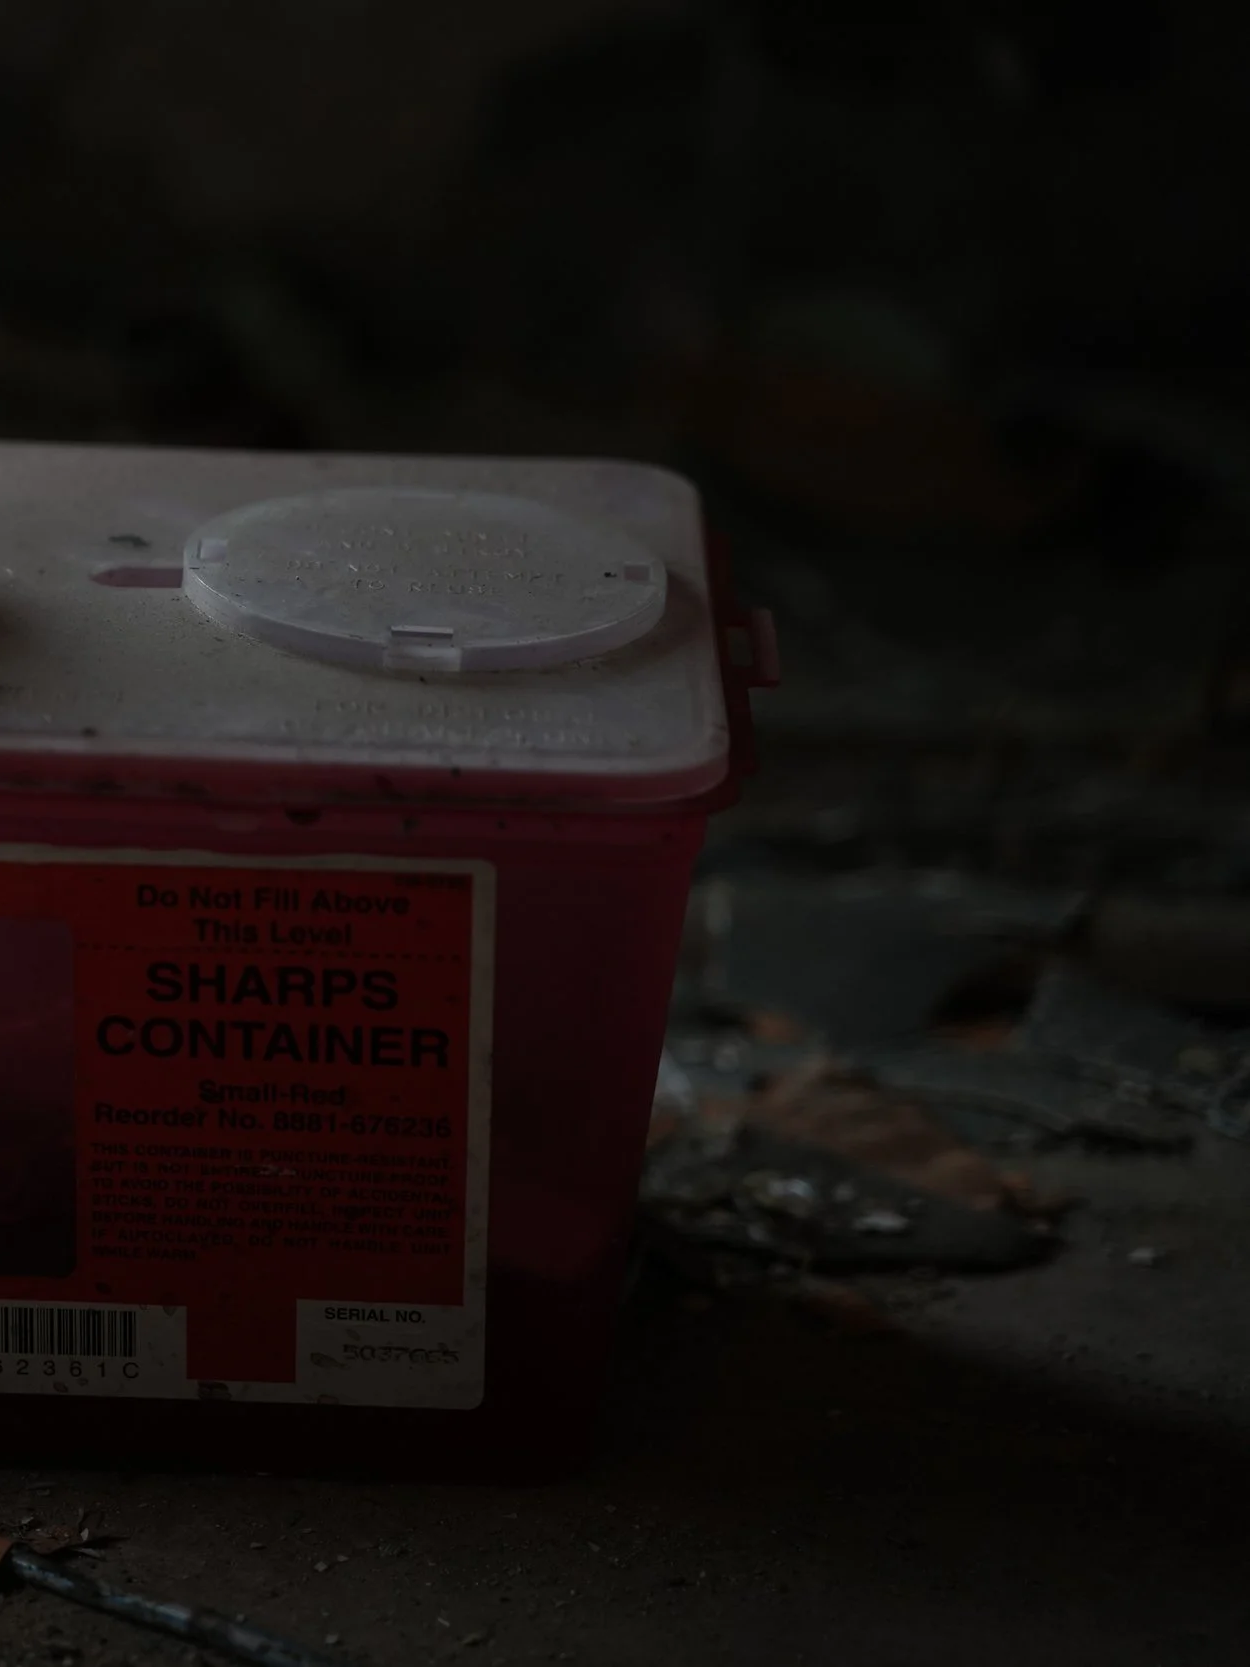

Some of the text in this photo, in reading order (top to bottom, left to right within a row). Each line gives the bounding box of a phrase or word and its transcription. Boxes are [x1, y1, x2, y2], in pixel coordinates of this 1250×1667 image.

[136, 883, 411, 916] Do Not Fill Above
[193, 917, 353, 946] This Level
[145, 961, 399, 1010] SHARPS
[96, 1014, 450, 1068] CONTAINER
[198, 1080, 347, 1106] Small-Red
[94, 1101, 207, 1130] Reorder
[218, 1107, 264, 1131] No.
[91, 1142, 129, 1156] THIS
[134, 1144, 232, 1159] CONTAINER
[158, 1162, 191, 1174] NOT
[175, 1180, 205, 1193] THE
[165, 1196, 189, 1209] DO
[324, 1306, 426, 1324] SERIAL NO.
